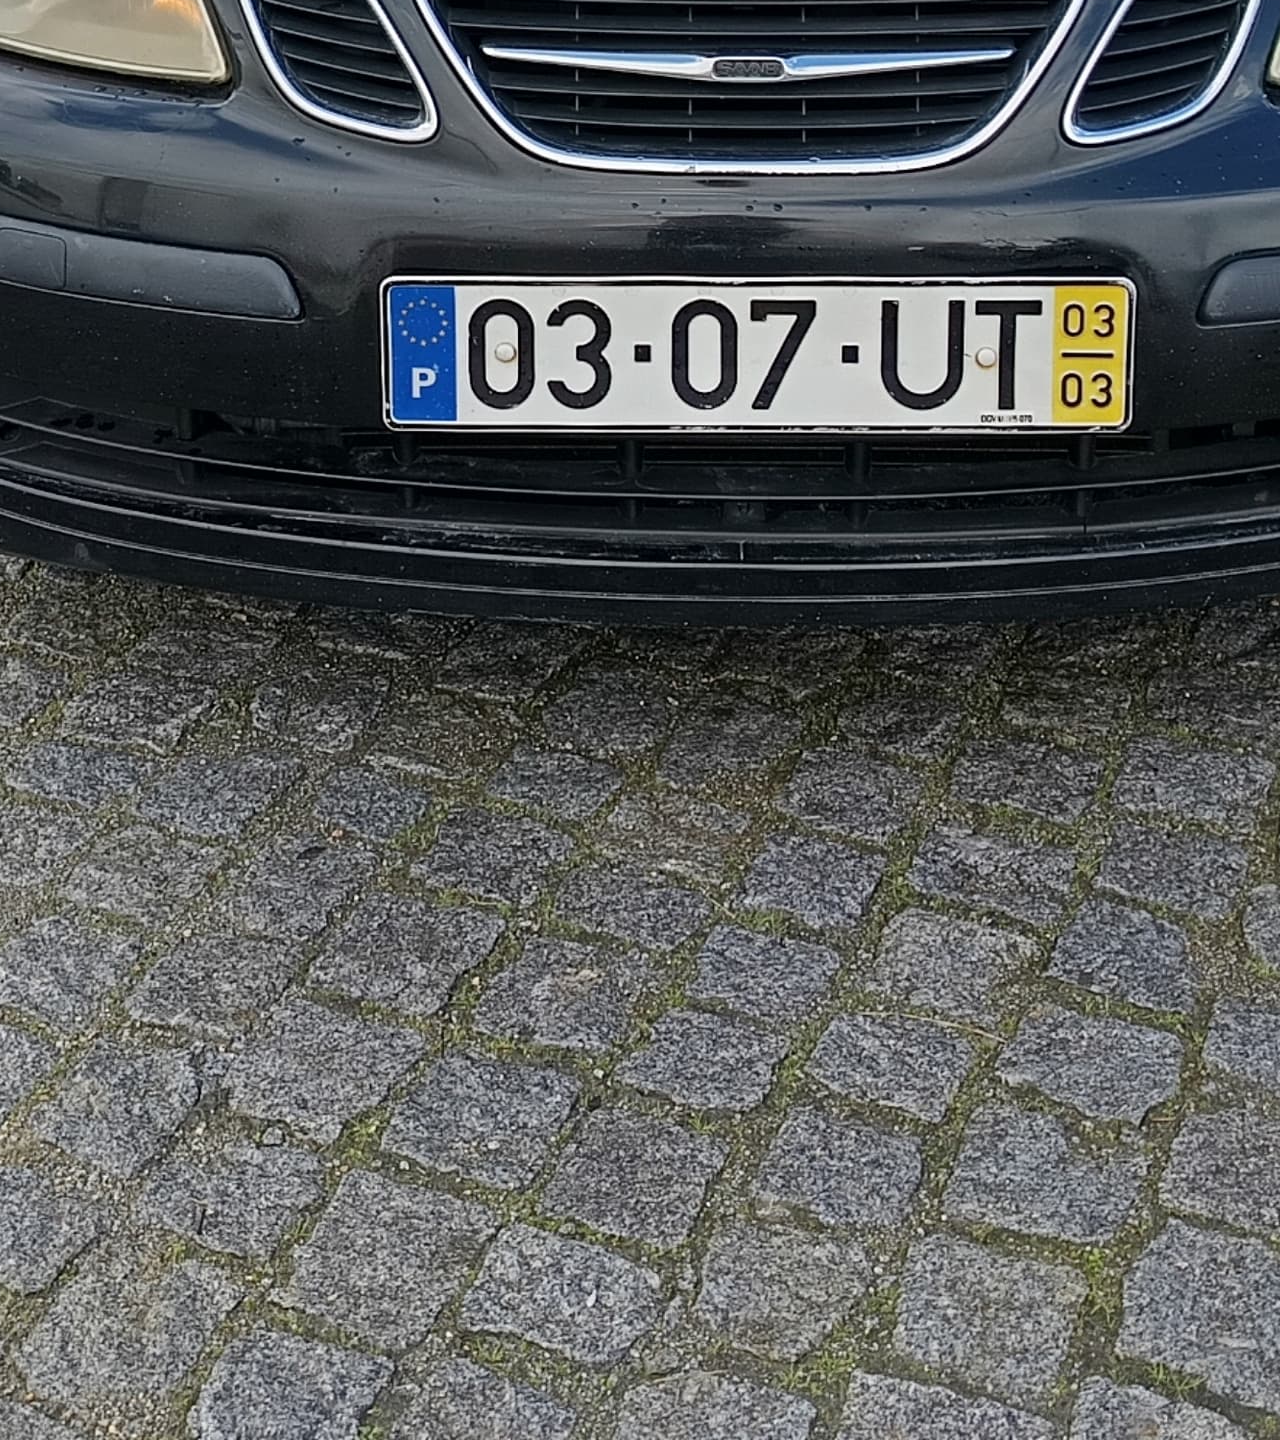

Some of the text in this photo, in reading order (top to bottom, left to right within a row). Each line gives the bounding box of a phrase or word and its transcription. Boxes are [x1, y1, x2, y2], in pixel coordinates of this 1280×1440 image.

[1063, 303, 1115, 337] 03
[411, 366, 436, 398] P
[1061, 372, 1112, 408] 03
